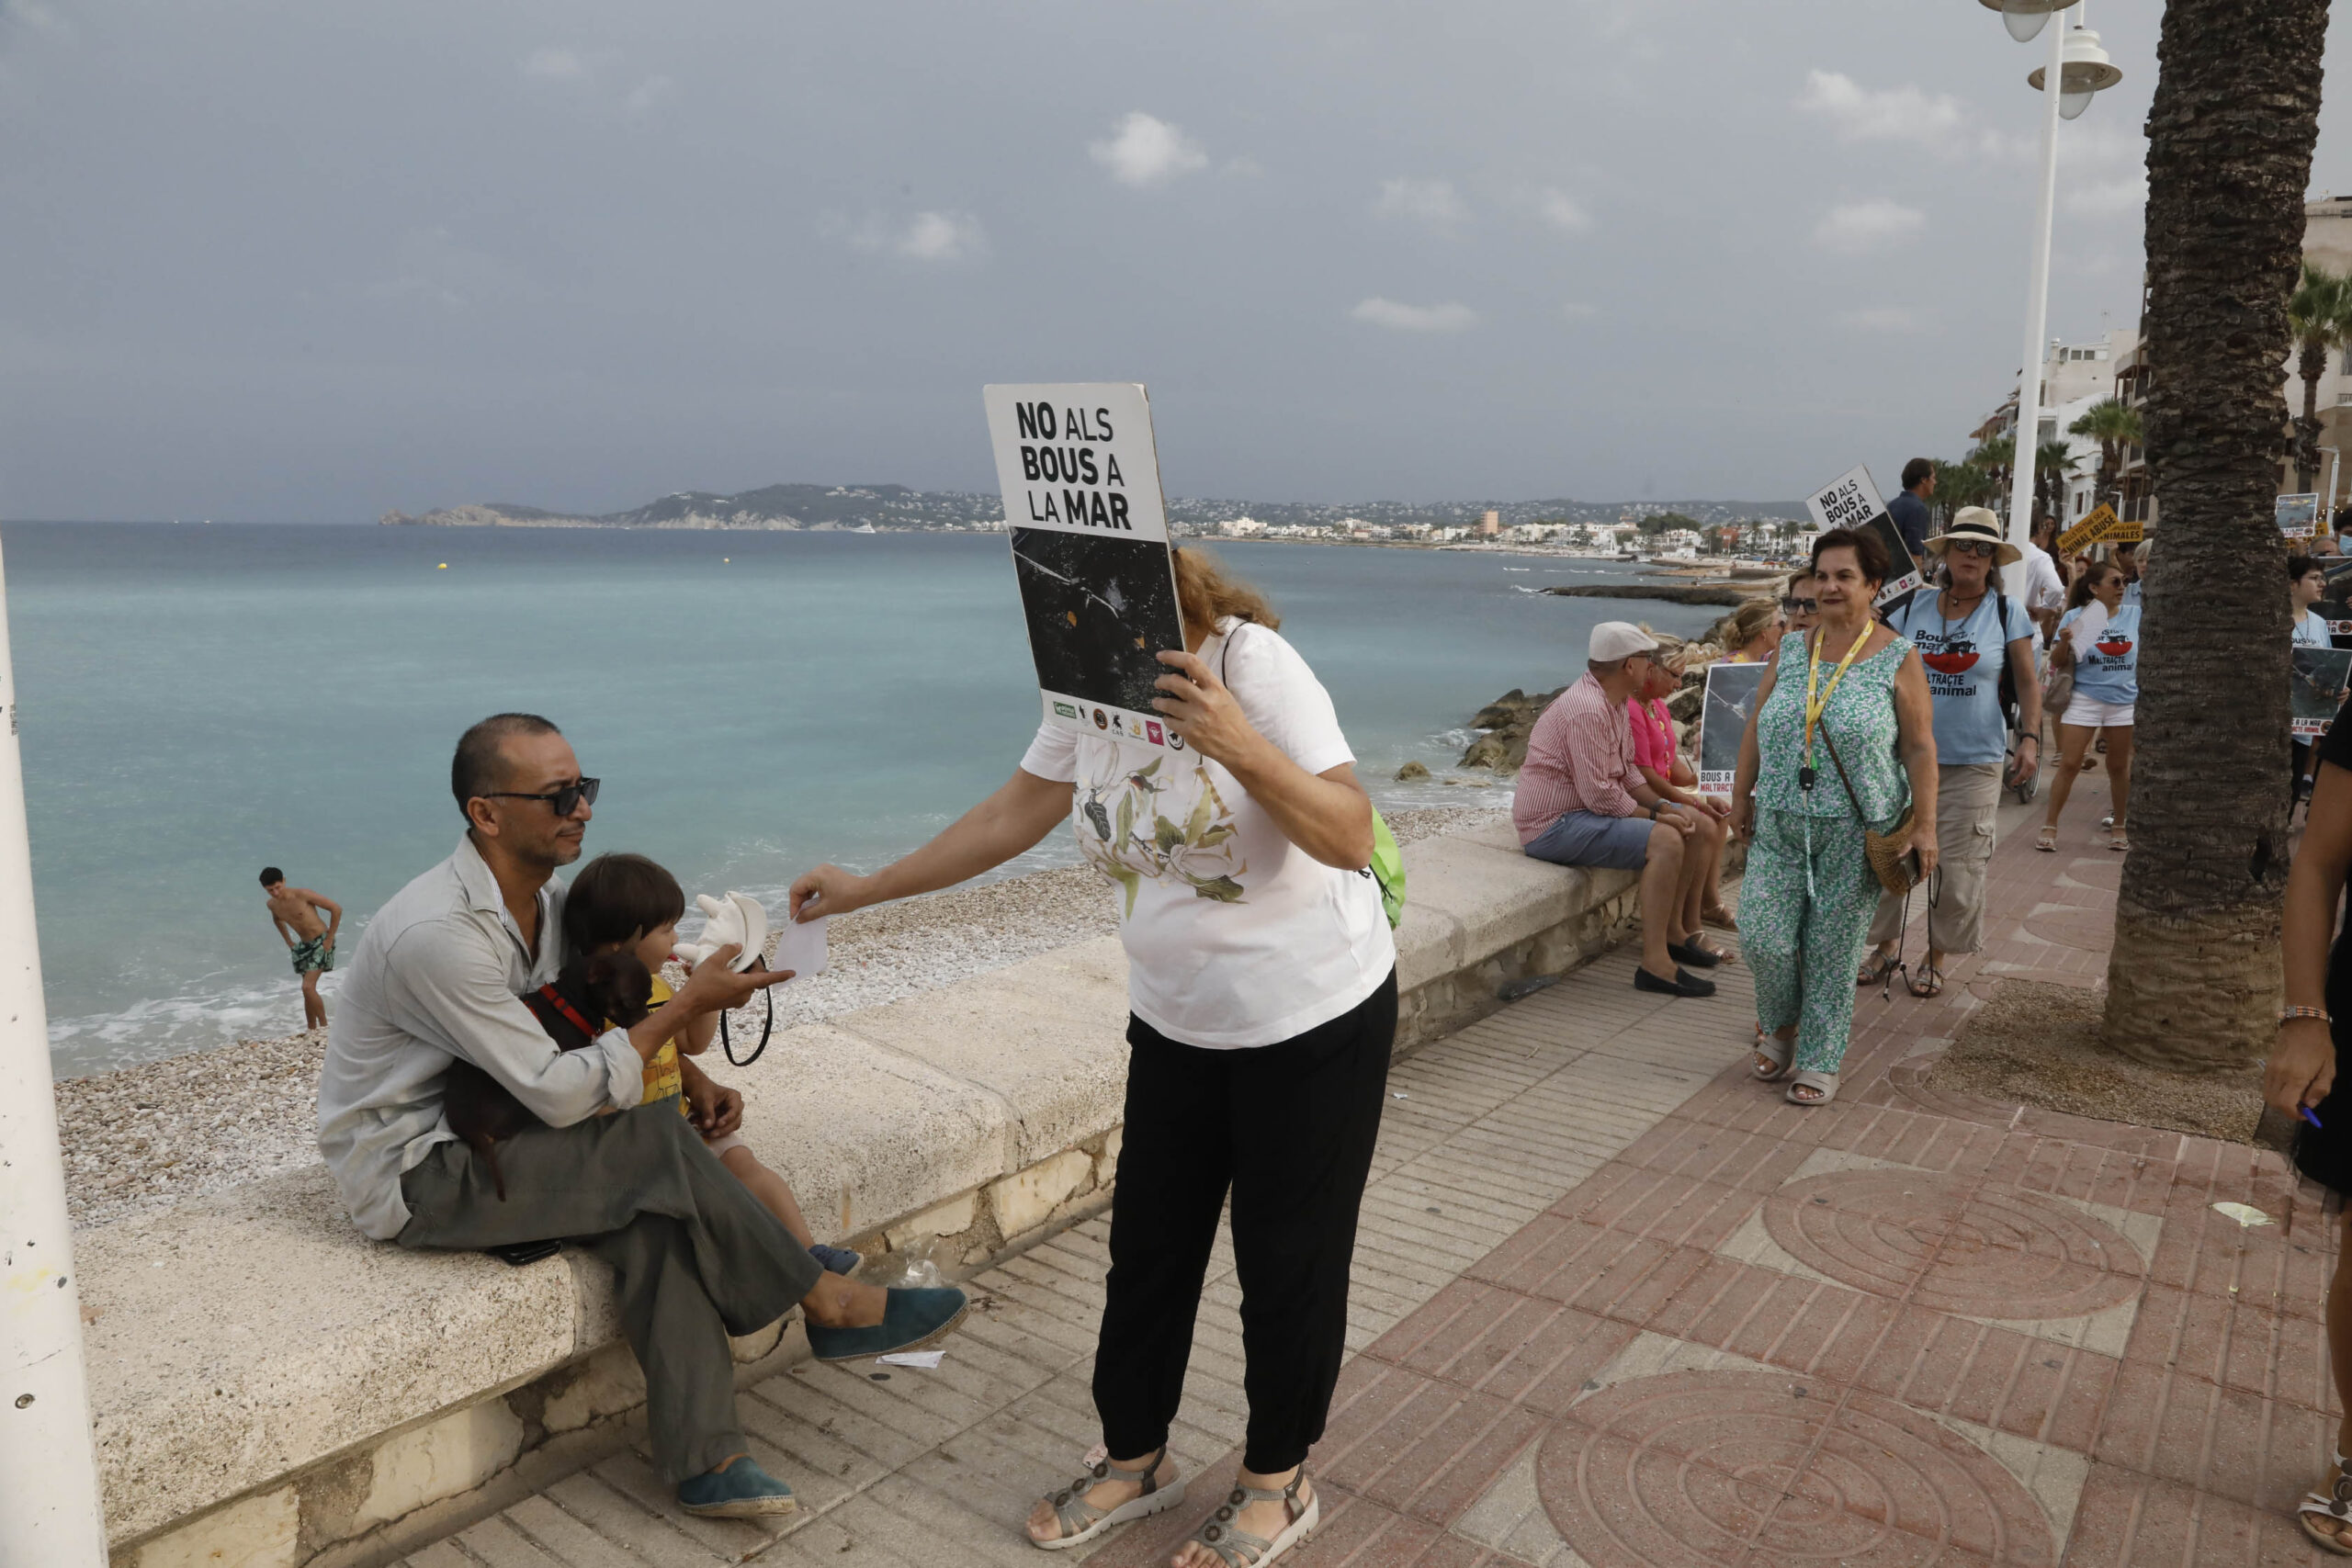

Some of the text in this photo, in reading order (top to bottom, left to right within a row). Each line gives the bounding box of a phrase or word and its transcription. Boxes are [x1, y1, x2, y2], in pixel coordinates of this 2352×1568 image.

[1015, 401, 1114, 443] NO ALS
[1020, 446, 1125, 487] BOUS A
[1819, 479, 1858, 510] NO ALS
[1826, 492, 1866, 524] BOUS A
[1027, 489, 1133, 531] LA MAR
[1845, 504, 1873, 529] MAR
[2089, 514, 2116, 538] ABUSE
[1930, 684, 1977, 697] animal
[1701, 772, 1722, 783] BOUS
[1724, 772, 1731, 783] A
[1701, 783, 1734, 793] MALTRACT
